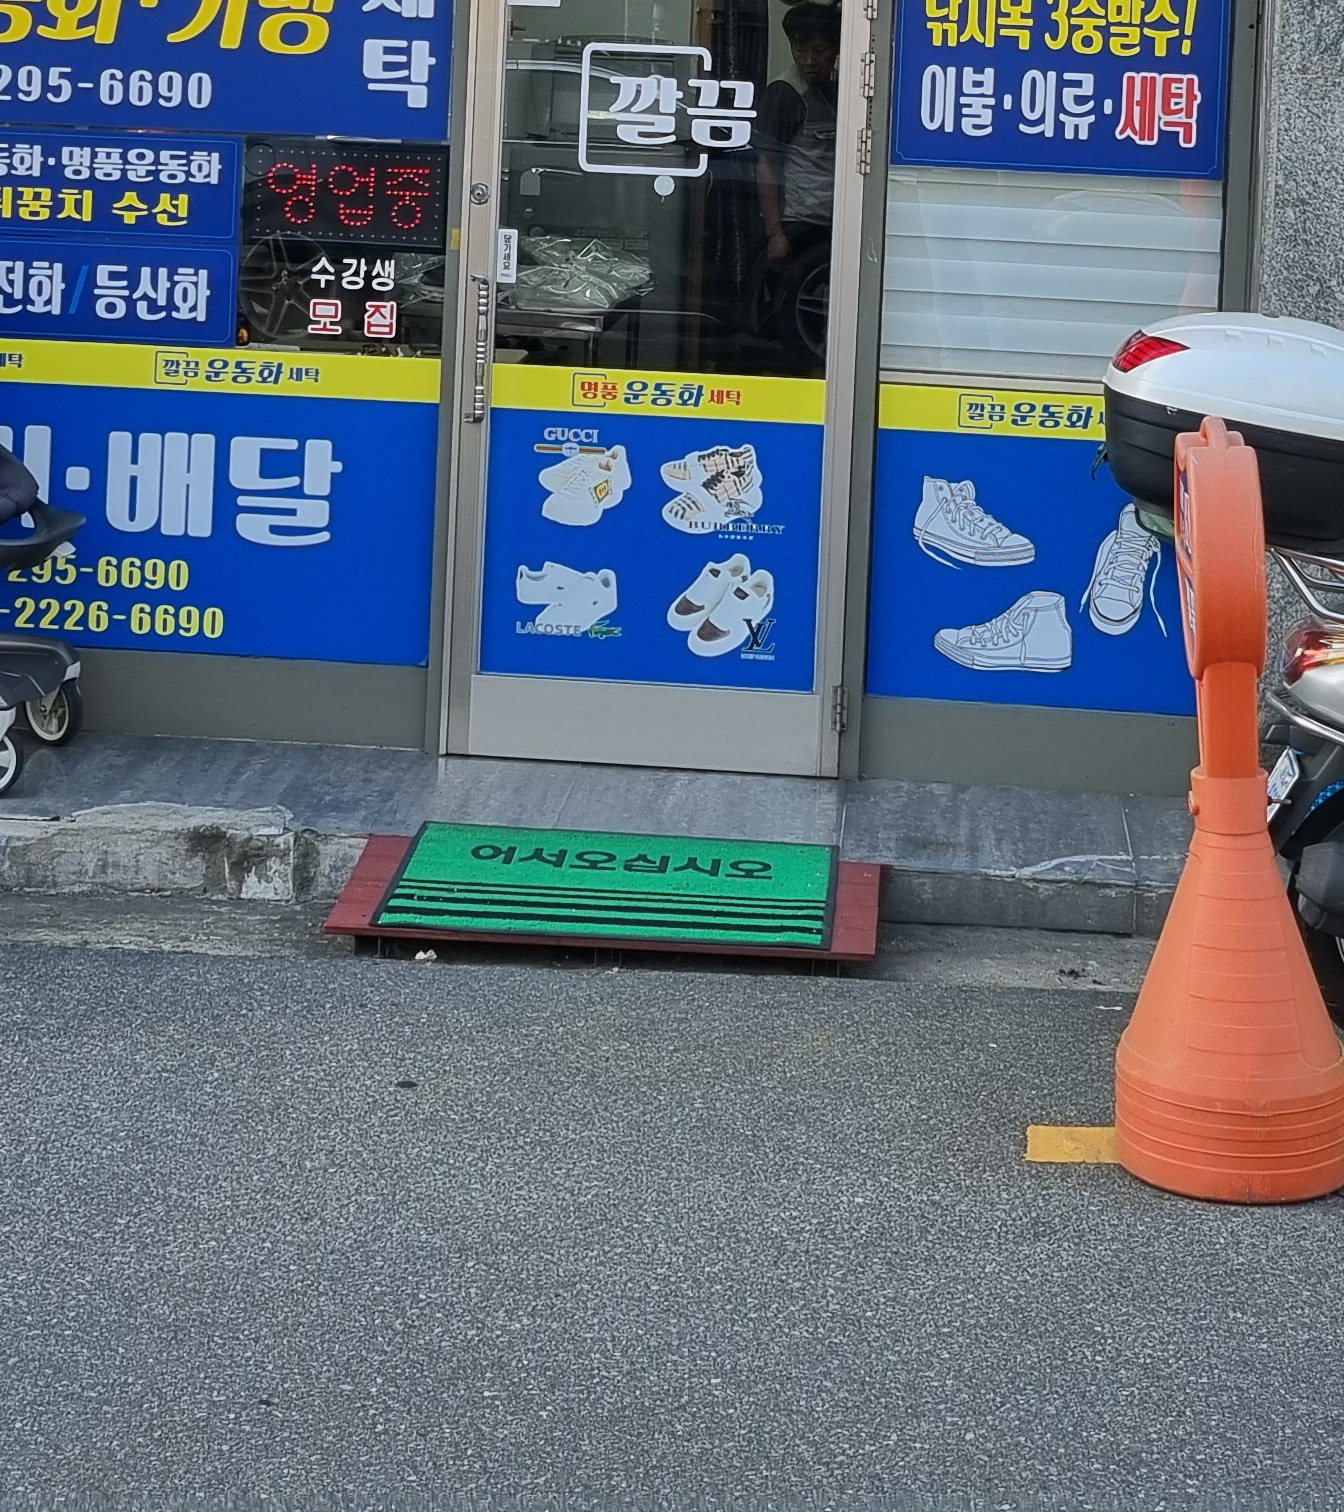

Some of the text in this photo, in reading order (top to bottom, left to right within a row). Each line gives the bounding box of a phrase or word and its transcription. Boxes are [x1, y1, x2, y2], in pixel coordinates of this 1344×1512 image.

[608, 75, 758, 149] 깔끔
[111, 191, 190, 227] 수선
[267, 161, 432, 229] 영업중
[310, 256, 396, 291] 수강생
[162, 357, 321, 385] 깔끔 운동화 세탁
[579, 379, 744, 407] 명품 운동화 세탁
[966, 401, 1007, 422] 깔끔
[1009, 401, 1094, 430] 운동화
[543, 427, 600, 444] GUCCI
[688, 520, 786, 535] BURBERRY
[514, 620, 583, 638] LACOSTE
[469, 841, 774, 880] 어서오십시오
